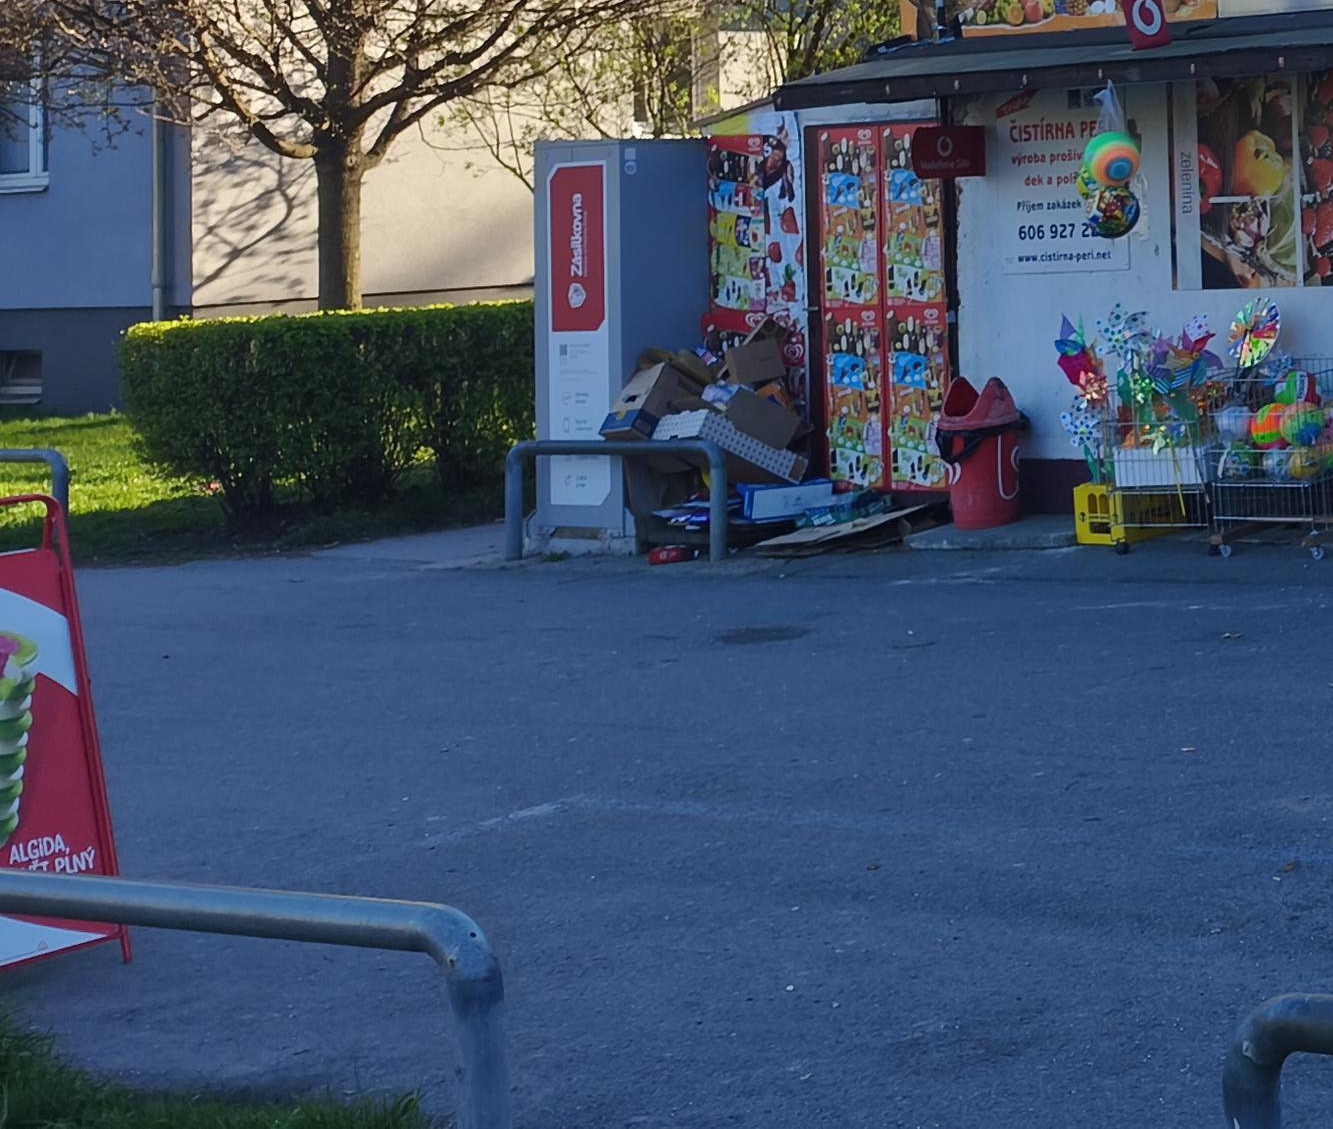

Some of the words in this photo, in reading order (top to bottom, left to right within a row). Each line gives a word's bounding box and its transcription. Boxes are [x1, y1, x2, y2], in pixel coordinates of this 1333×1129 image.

[1009, 117, 1075, 143] ČISTÍRNA
[1080, 120, 1098, 138] PE
[1011, 151, 1046, 167] výroba
[1050, 148, 1083, 167] prošiv
[1024, 174, 1045, 187] dek
[1048, 176, 1055, 186] a
[1179, 150, 1193, 214] zelenina
[1016, 198, 1044, 214] Příjem
[1047, 198, 1082, 211] zakázek
[570, 193, 583, 277] Zásilkovna
[1018, 224, 1045, 240] 606
[1050, 223, 1075, 239] 927
[1017, 250, 1112, 263] www.cistirna-peri.net
[54, 846, 96, 874] PLNÝ
